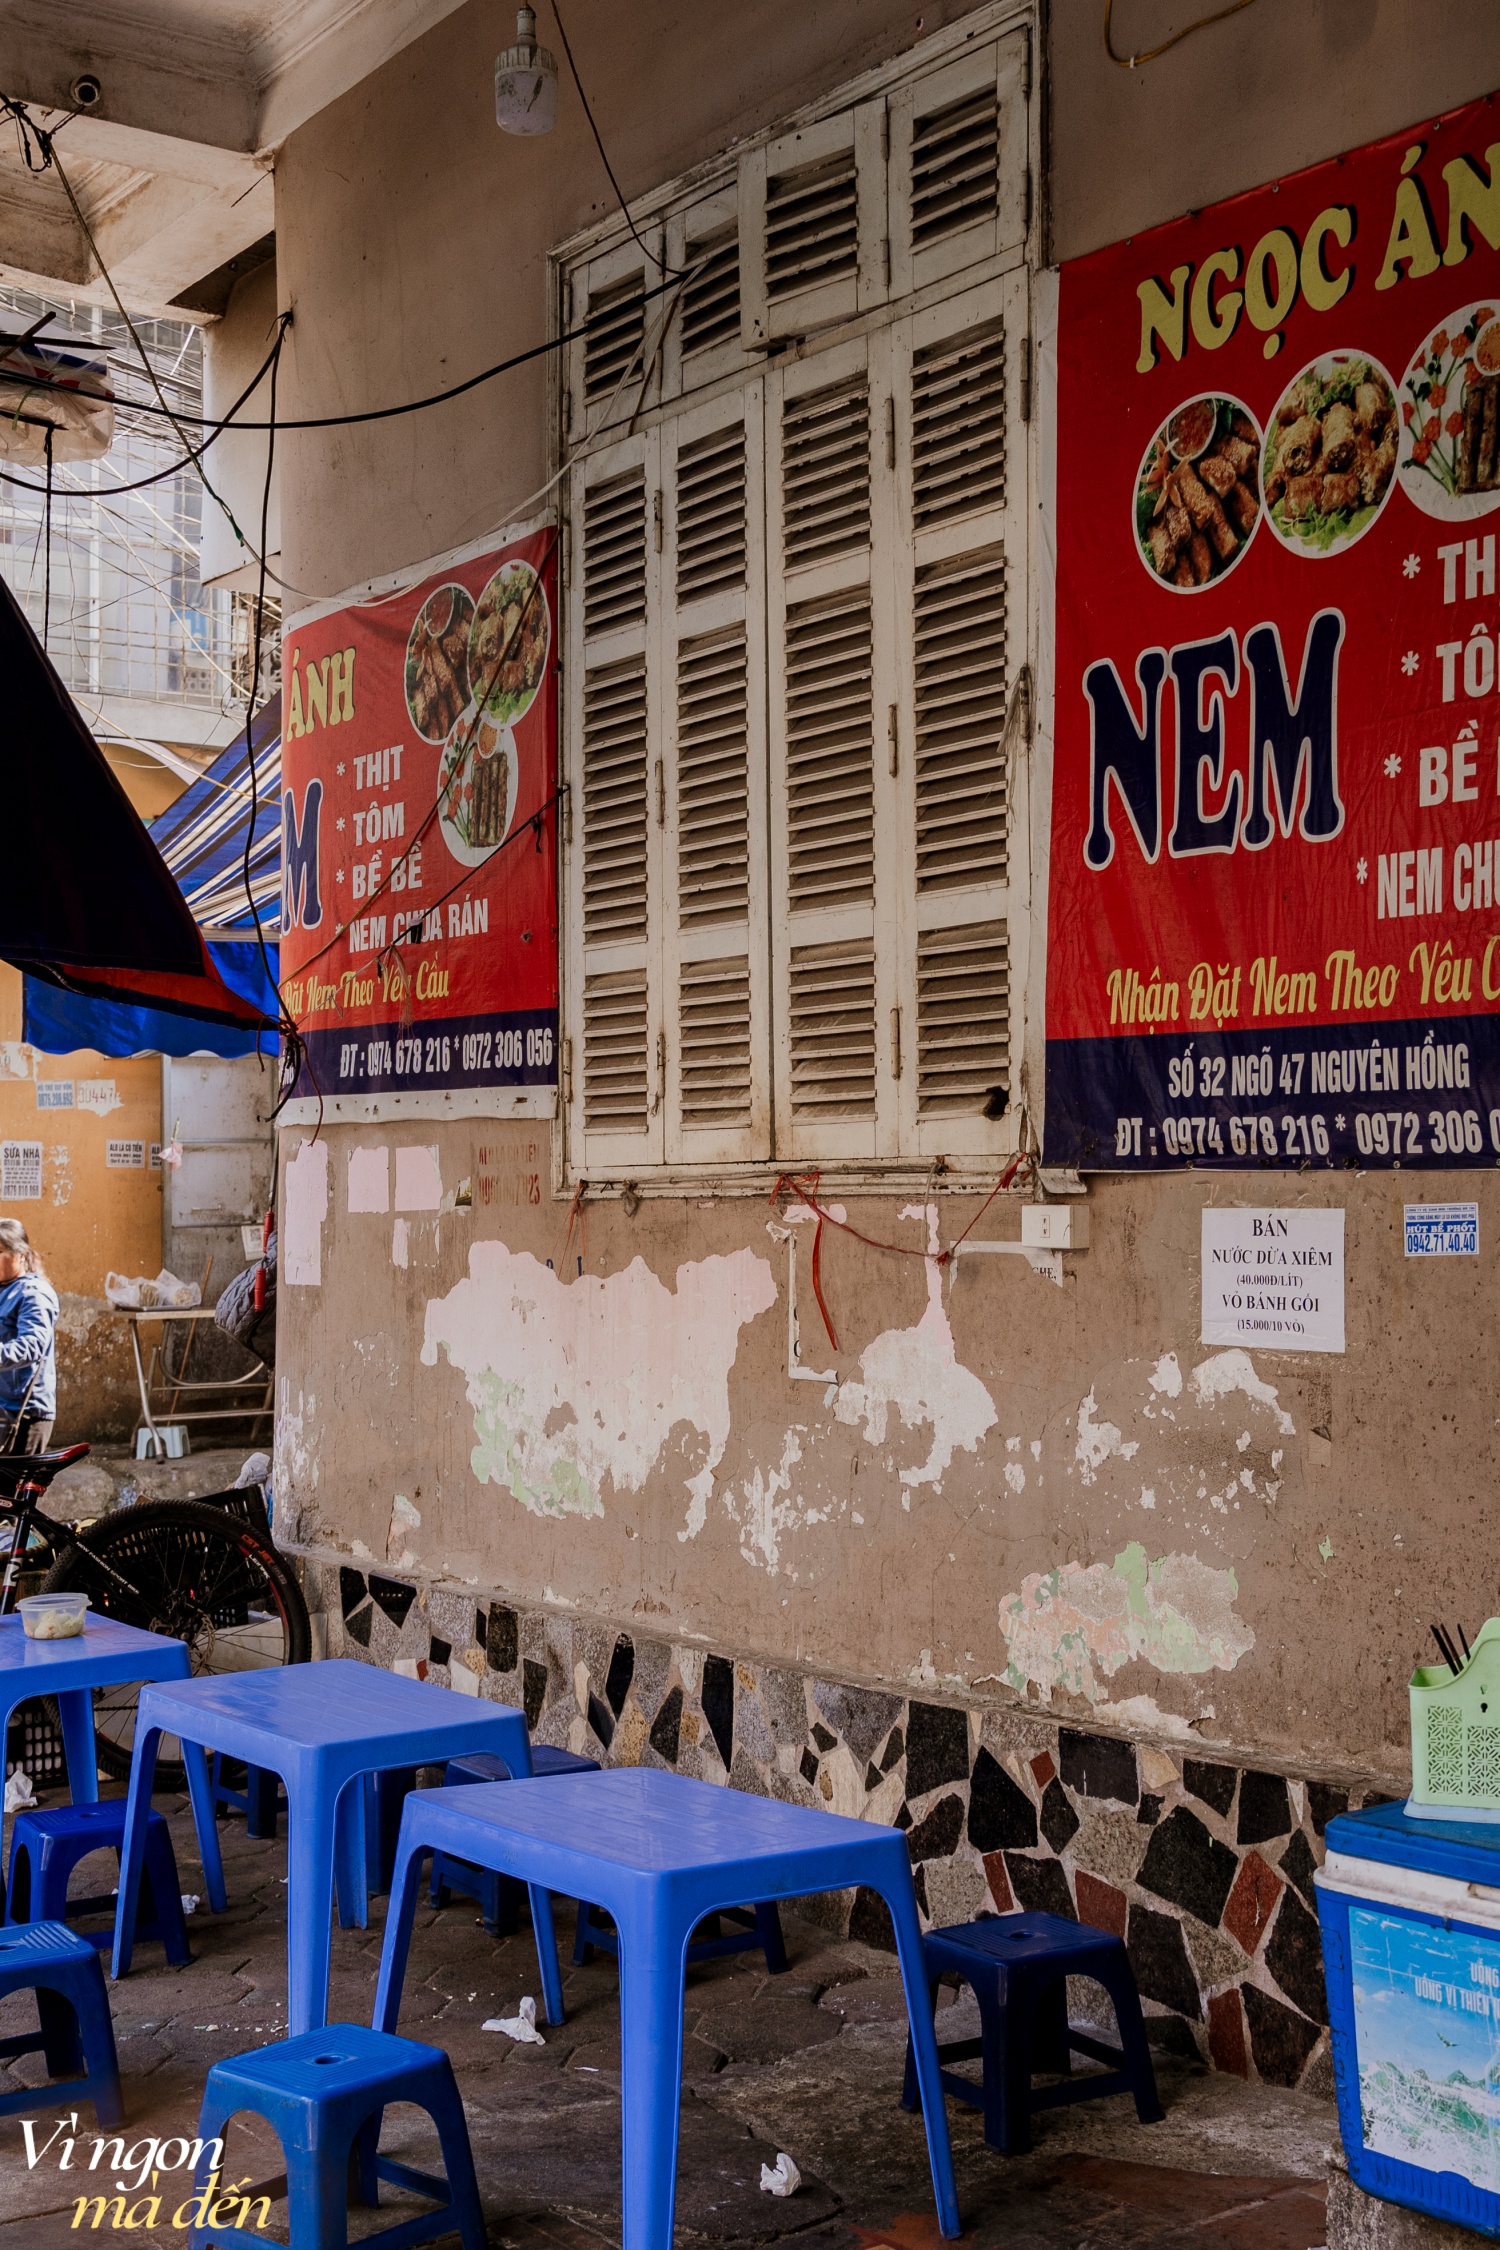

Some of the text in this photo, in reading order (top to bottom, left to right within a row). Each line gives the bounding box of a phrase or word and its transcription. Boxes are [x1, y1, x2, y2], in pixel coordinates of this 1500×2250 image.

[1136, 206, 1354, 374] NGỌC
[1436, 622, 1500, 703] TÔ
[286, 646, 356, 742] ÁNH
[1083, 607, 1346, 871] NEM
[1419, 719, 1479, 808] BỀ
[353, 744, 404, 791] THỊT
[353, 801, 405, 846] TÔM
[353, 841, 422, 899] BỀ BỀ
[1378, 847, 1443, 919] NEM
[349, 915, 387, 954] NEM
[448, 894, 488, 938] RÁN
[306, 976, 337, 1013] Nem
[340, 970, 374, 1008] Theo
[416, 951, 449, 1000] Cầu
[1106, 965, 1179, 1034] Nhận
[1187, 962, 1241, 1028] Đặt
[1249, 956, 1317, 1016] Nem
[1325, 950, 1400, 1010] Theo
[1409, 938, 1472, 1004] Yêu
[367, 1041, 392, 1076] 0974
[395, 1038, 422, 1074] 678
[425, 1036, 450, 1073] 216
[463, 1032, 491, 1070] 0972
[495, 1030, 522, 1068] 306
[526, 1027, 553, 1066] 056
[1168, 1030, 1470, 1098] SỐ 32 NGÕ 47 NGUYÊN HỒNG
[1162, 1116, 1224, 1156] 0974
[1229, 1115, 1279, 1156] 678
[1281, 1114, 1330, 1156] 216
[1356, 1112, 1423, 1155] 0972
[1429, 1110, 1482, 1154] 306
[1252, 1214, 1288, 1237] BÁN
[1407, 1224, 1428, 1233] HÚT
[1447, 1221, 1475, 1232] PHỐT
[1407, 1233, 1475, 1253] 0942.71.40.40
[1212, 1245, 1332, 1266] NƯỚC DỪA XIÊM
[1222, 1290, 1320, 1312] VỎ BÁNH GỐI
[1236, 1272, 1303, 1289] (40.000Đ/LÍT)
[1237, 1318, 1305, 1335] (15.000/10 VỎ)
[76, 1541, 90, 1552] NEW
[89, 1551, 111, 1571] FASHION
